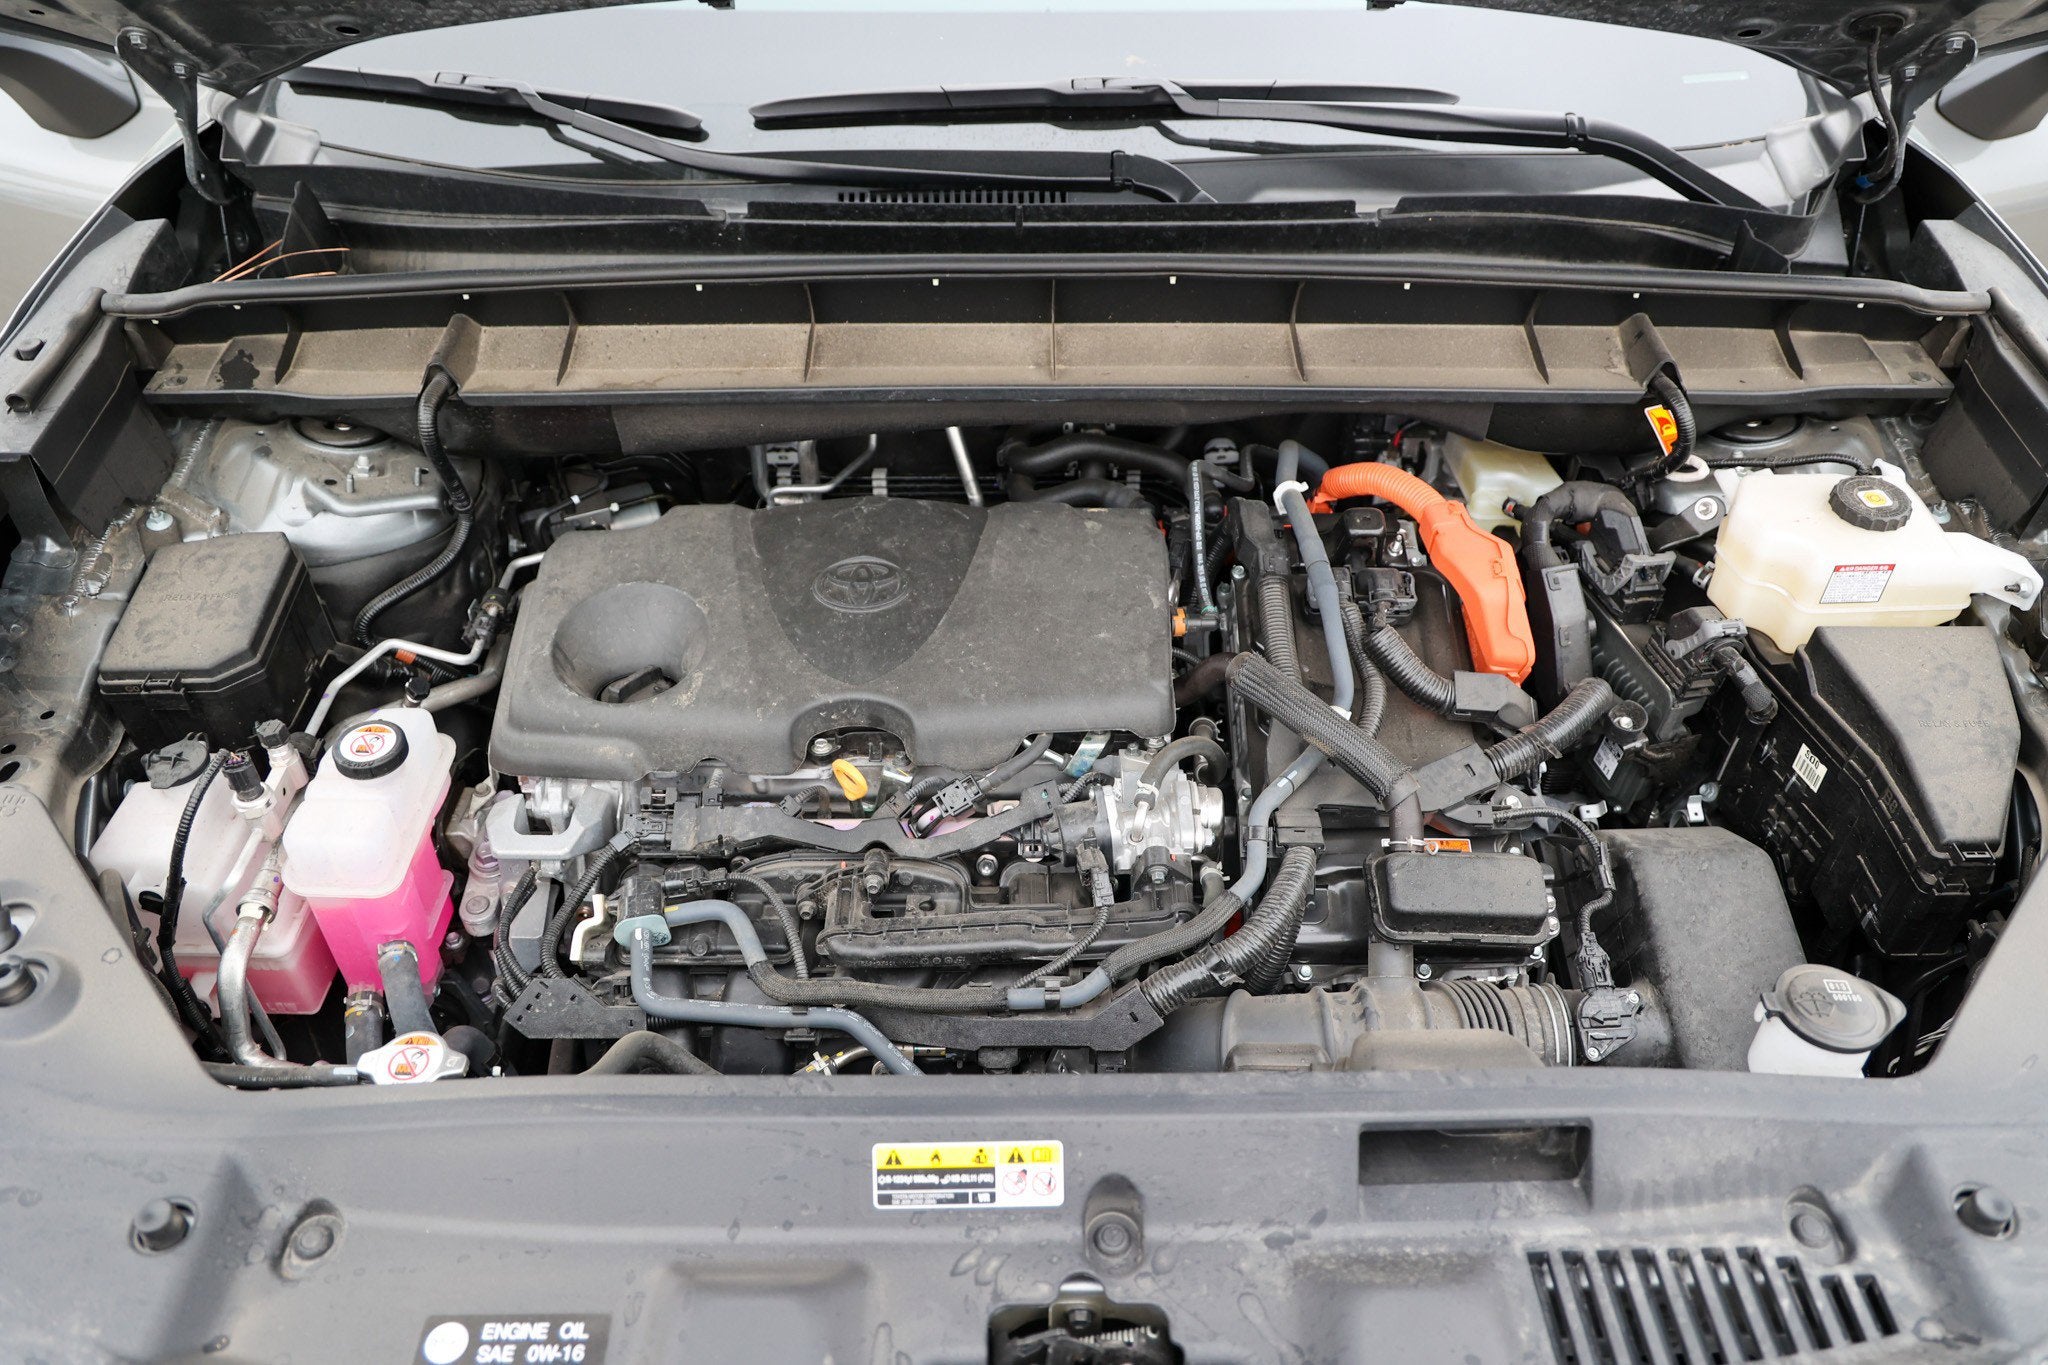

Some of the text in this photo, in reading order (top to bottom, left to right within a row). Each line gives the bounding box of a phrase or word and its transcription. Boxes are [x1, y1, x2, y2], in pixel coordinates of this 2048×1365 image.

[480, 1321, 590, 1341] ENGINE OIL
[475, 1343, 586, 1364] SAE 0W-16
